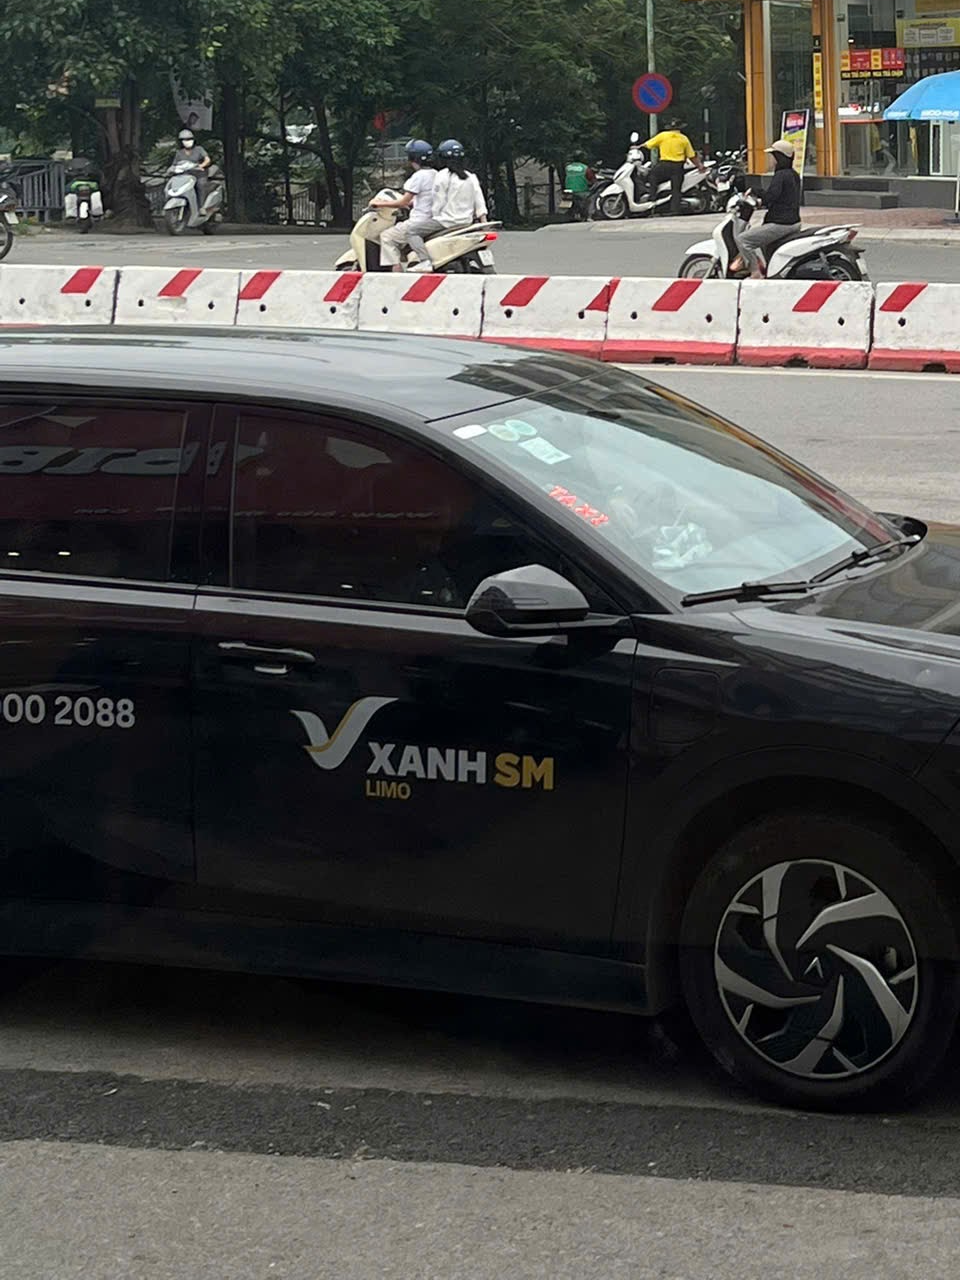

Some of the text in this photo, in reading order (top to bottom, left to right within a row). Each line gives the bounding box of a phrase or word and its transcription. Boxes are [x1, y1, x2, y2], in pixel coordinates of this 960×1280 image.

[54, 696, 136, 729] 2088
[366, 741, 554, 790] XANH SM
[365, 779, 412, 800] LIMO
